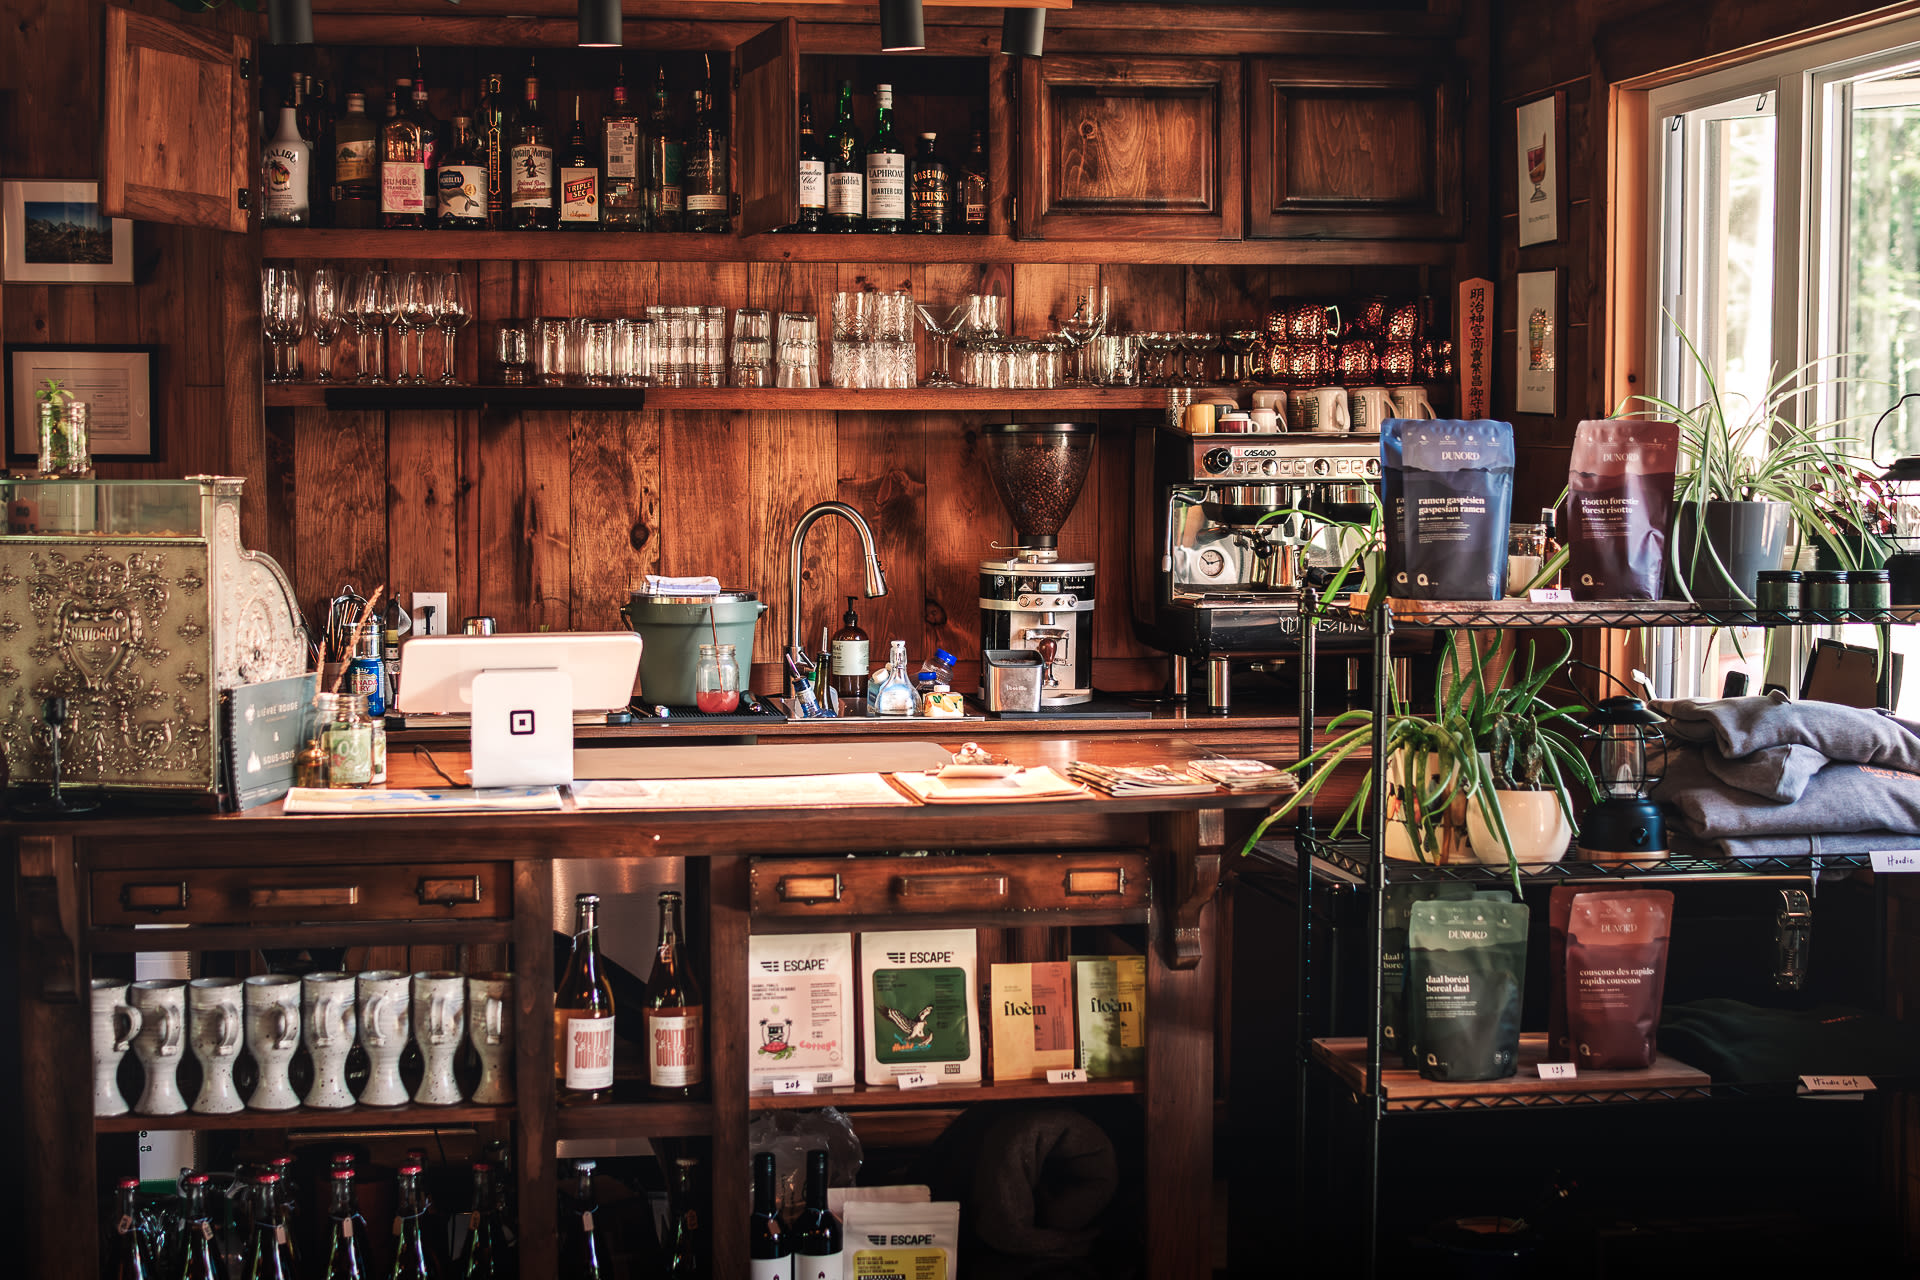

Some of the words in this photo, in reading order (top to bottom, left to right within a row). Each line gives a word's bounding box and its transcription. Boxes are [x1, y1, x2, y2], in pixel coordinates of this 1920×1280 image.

[913, 170, 949, 183] ROSEMONT
[383, 178, 416, 186] HUMBLE
[567, 181, 592, 193] TRIPLE
[572, 190, 587, 199] SEC
[912, 192, 949, 201] WHISKY
[1244, 449, 1277, 457] CASADIO
[1441, 451, 1480, 461] DUNORD
[1446, 496, 1485, 506] gaspésien
[1418, 505, 1459, 516] gaspesian
[1460, 506, 1486, 514] ramen
[1582, 506, 1605, 514] forest
[910, 952, 951, 963] ESCAPE
[784, 959, 825, 971] ESCAPE
[1579, 969, 1615, 977] couscous
[1616, 968, 1629, 976] des
[1426, 975, 1443, 984] daal
[1444, 975, 1469, 984] boréal
[1580, 977, 1606, 987] rapids
[1606, 978, 1641, 986] couscous
[1426, 984, 1452, 993] boreal
[1453, 984, 1470, 993] daal
[1061, 1071, 1076, 1080] 14$
[891, 1235, 932, 1245] ESCAPE
